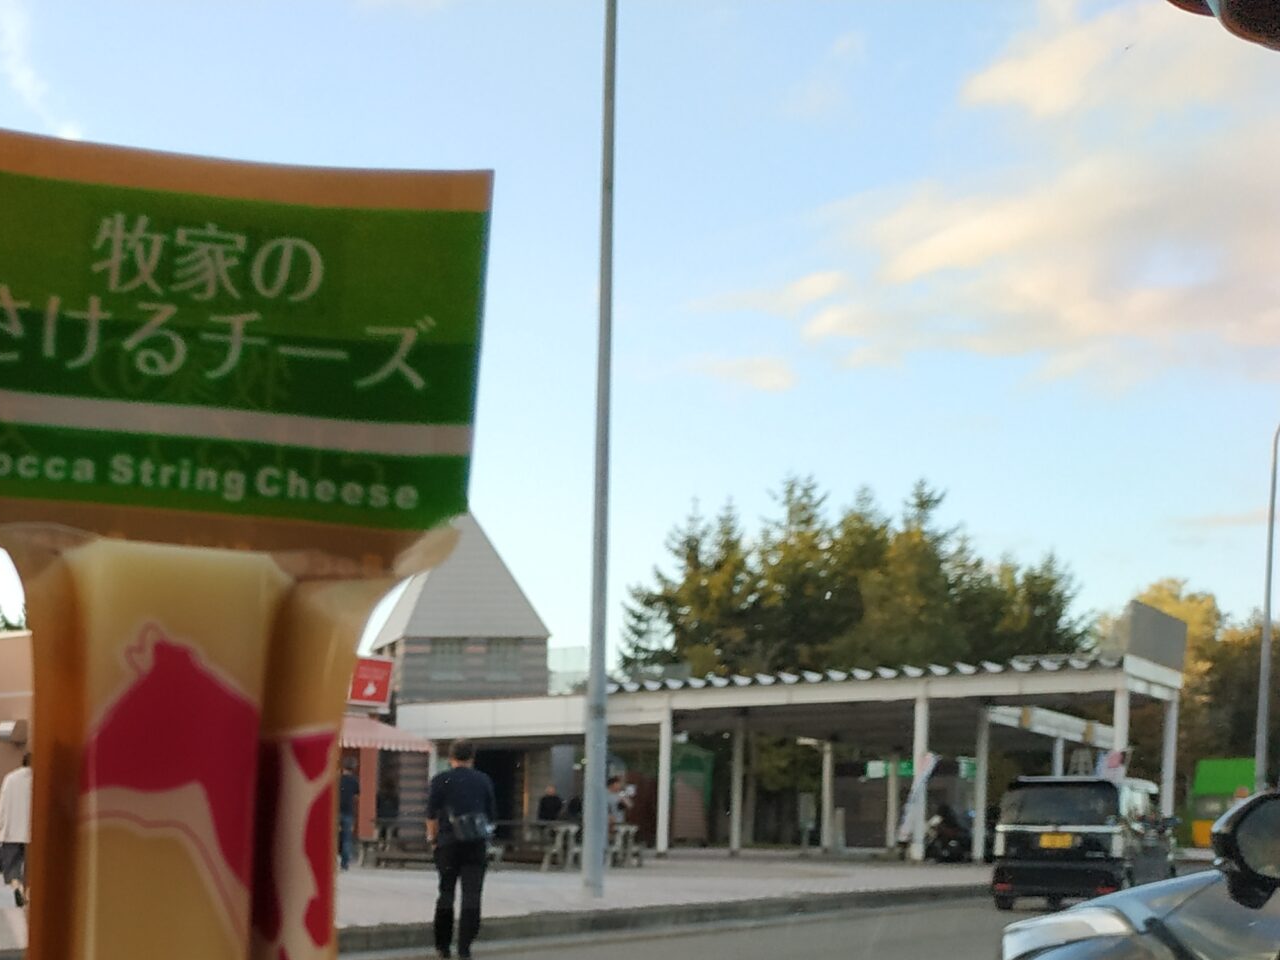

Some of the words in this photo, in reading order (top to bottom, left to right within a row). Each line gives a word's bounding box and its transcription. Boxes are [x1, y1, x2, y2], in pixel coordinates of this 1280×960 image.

[91, 213, 325, 301] 牧家の
[109, 453, 247, 501] String
[256, 465, 420, 510] Cheese
